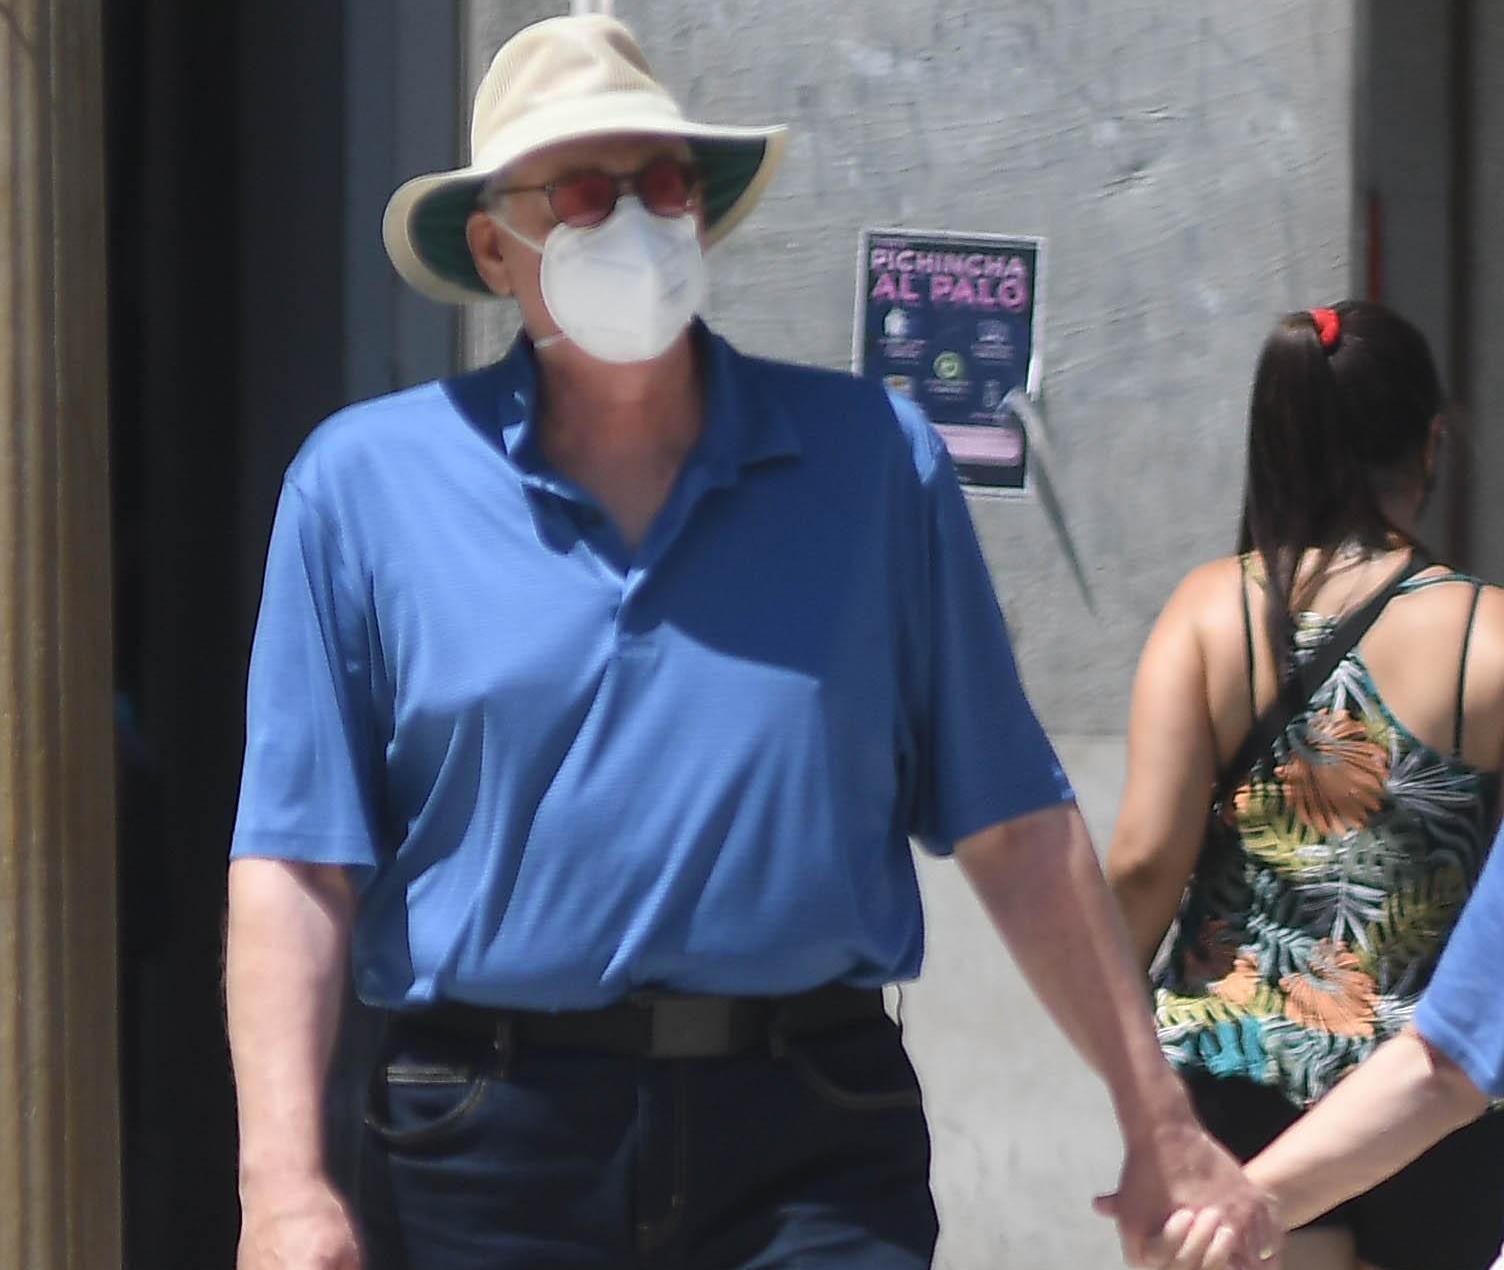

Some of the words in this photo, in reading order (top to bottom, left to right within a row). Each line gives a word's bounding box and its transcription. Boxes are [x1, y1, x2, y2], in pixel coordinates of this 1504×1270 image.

[871, 249, 1026, 278] PICHINCHA
[871, 272, 920, 302] AL
[930, 274, 1027, 309] PALO
